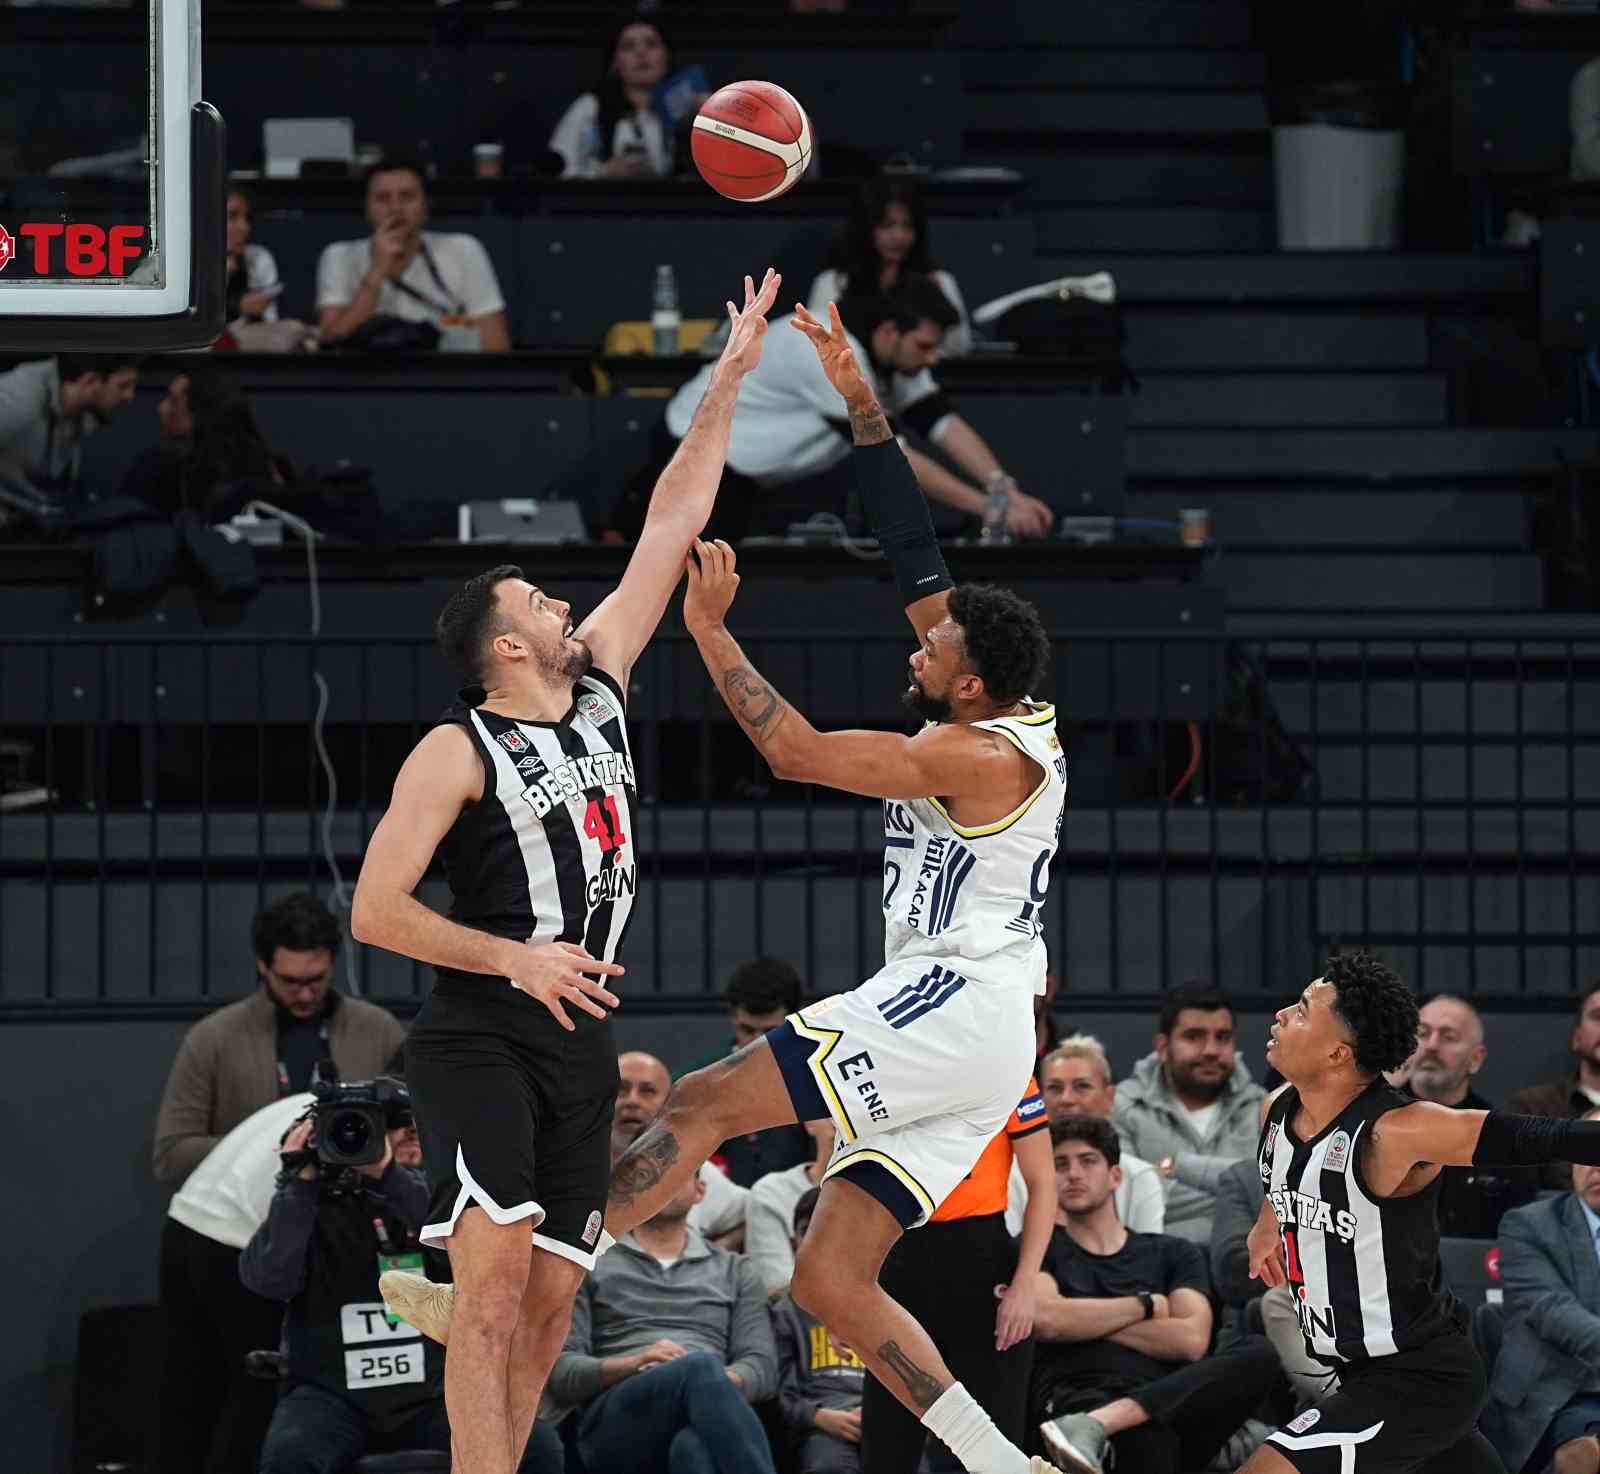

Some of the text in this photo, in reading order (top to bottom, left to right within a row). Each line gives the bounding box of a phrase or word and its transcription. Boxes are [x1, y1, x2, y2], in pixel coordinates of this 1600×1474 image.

[19, 223, 145, 276] TBF
[522, 765, 545, 777] umbro
[583, 795, 626, 853] 41
[585, 863, 635, 909] GAIN
[360, 1353, 411, 1380] 256
